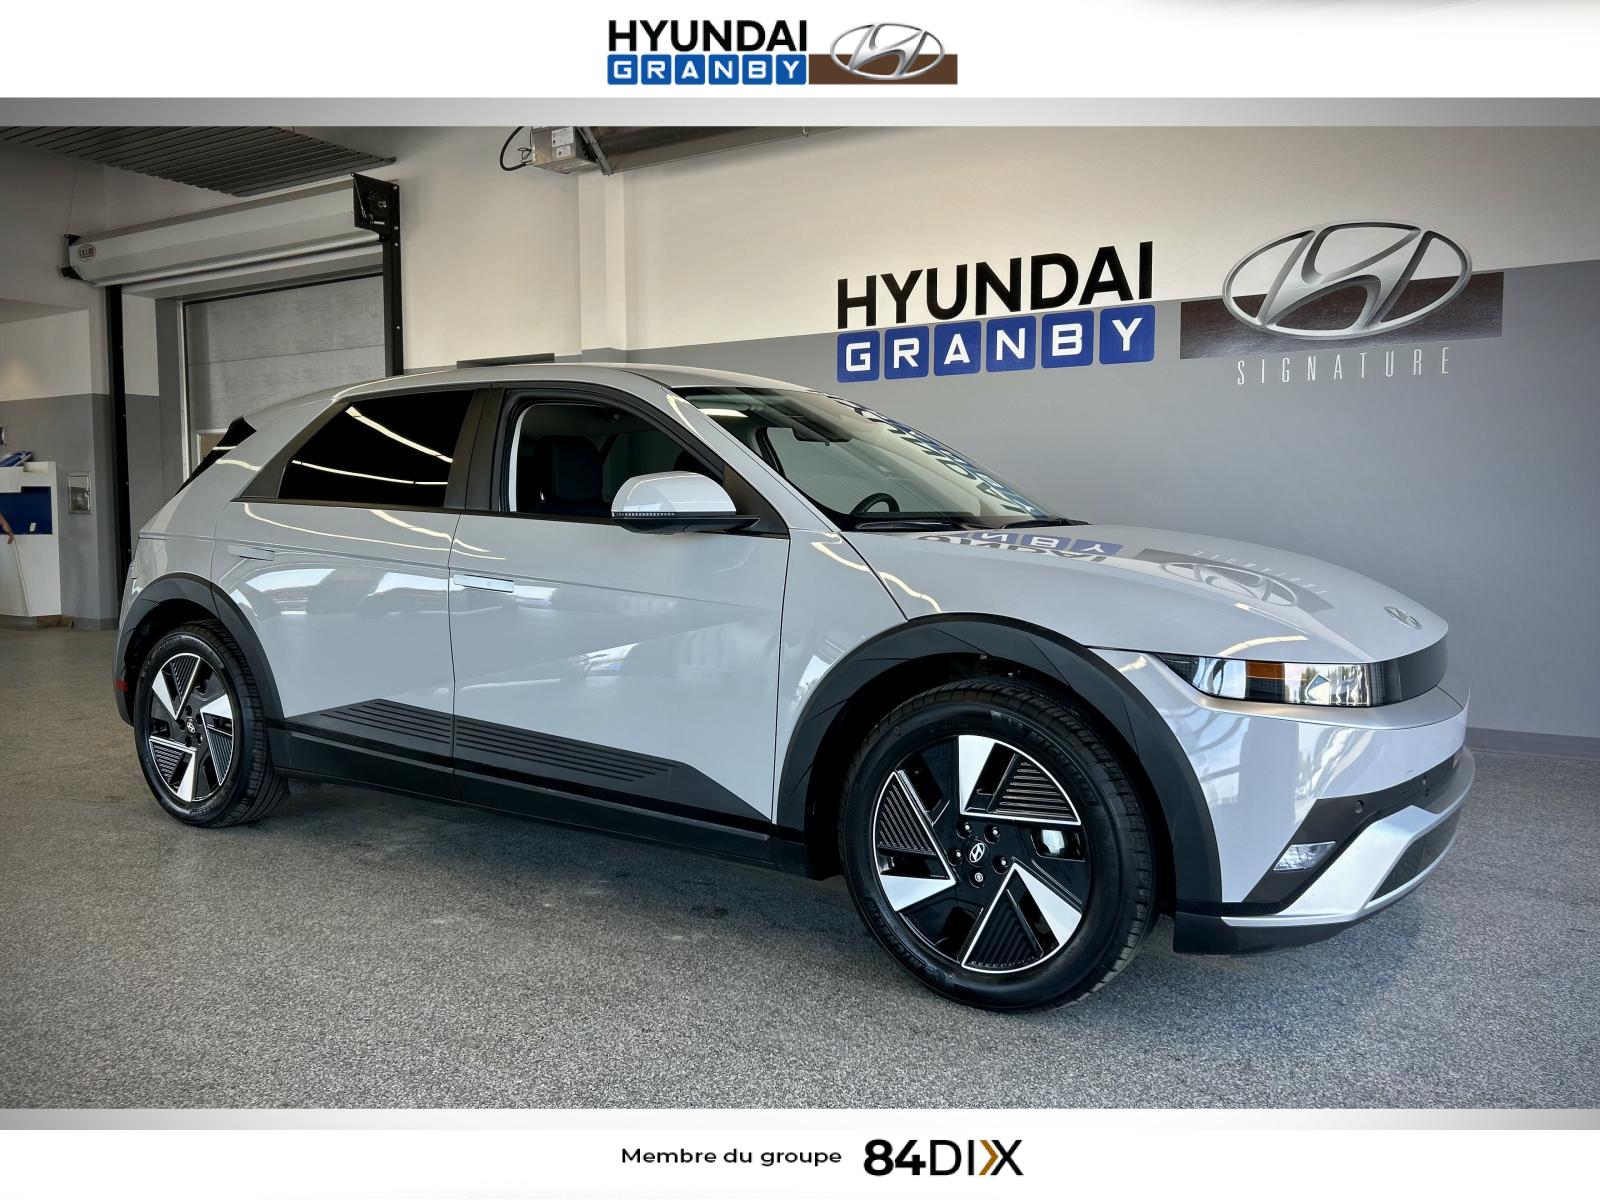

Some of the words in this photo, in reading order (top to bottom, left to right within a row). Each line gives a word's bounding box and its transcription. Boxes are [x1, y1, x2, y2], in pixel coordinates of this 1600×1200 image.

[837, 241, 1153, 329] HYUNDAI
[845, 317, 1143, 372] GRANBY
[1237, 346, 1451, 386] SIGNATURE
